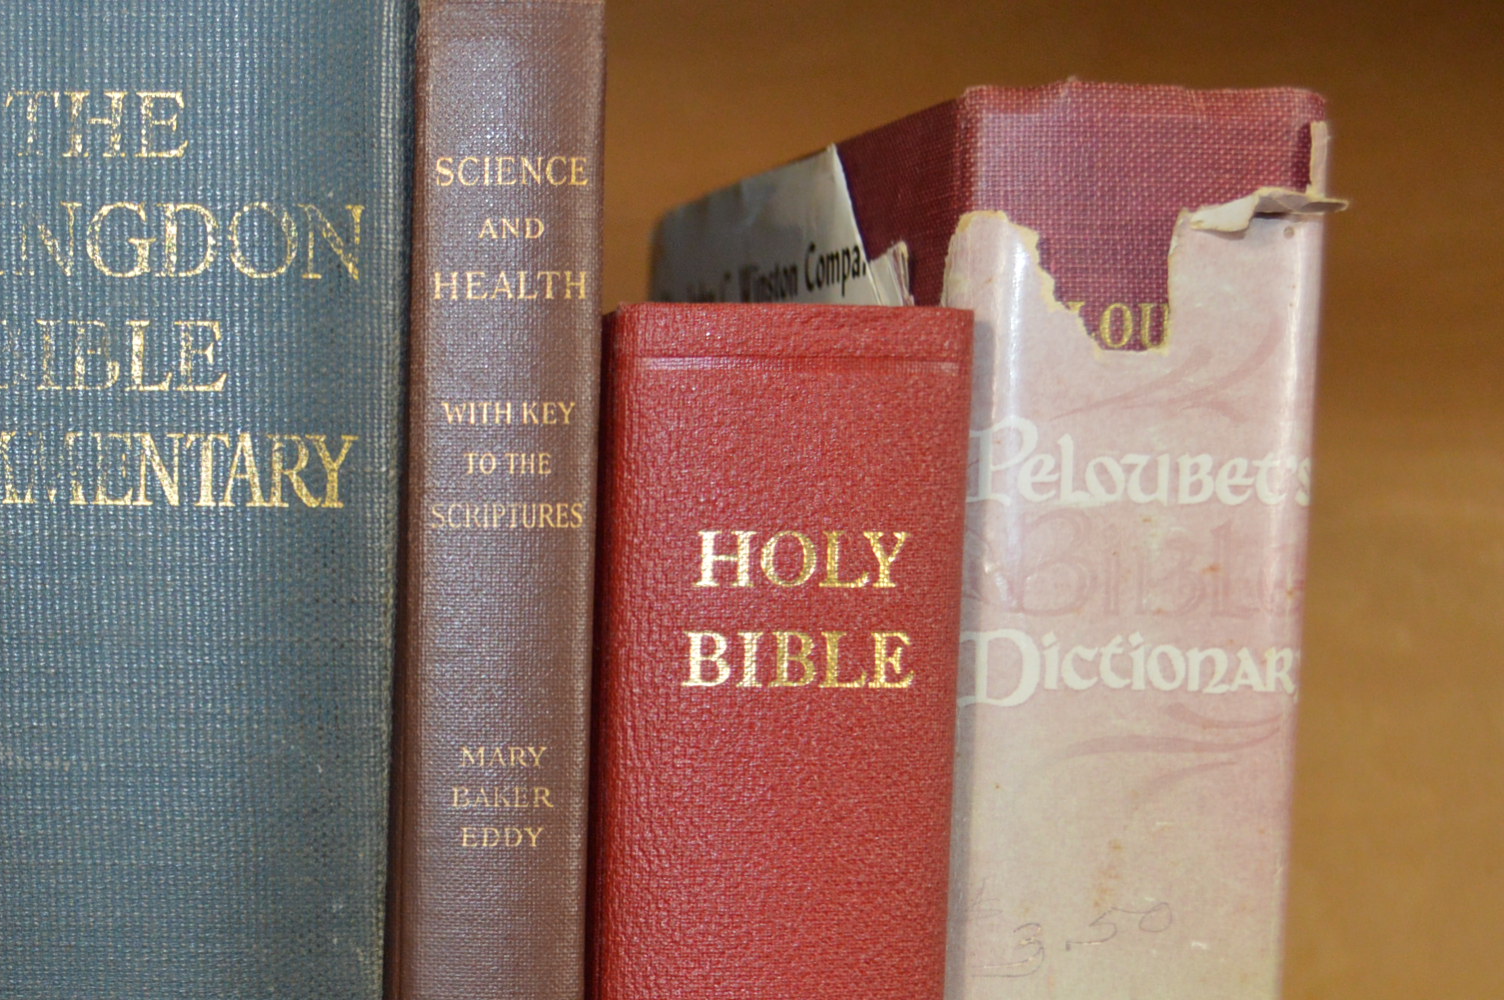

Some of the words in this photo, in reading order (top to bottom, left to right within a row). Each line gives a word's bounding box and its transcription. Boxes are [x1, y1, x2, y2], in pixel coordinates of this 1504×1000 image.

[4, 89, 190, 159] THE
[435, 155, 589, 188] SCIENCE
[477, 217, 545, 240] AND
[804, 241, 867, 298] Compa
[432, 270, 588, 301] HEALTH
[442, 402, 513, 425] WITH
[521, 402, 577, 426] KEY
[463, 452, 500, 475] TO
[504, 453, 552, 475] THE
[431, 502, 584, 530] SCRIPTURES
[693, 530, 911, 588] HOLY
[681, 630, 914, 688] BIBLE
[957, 628, 1300, 707] Dictionar
[459, 746, 548, 769] MARY
[451, 785, 555, 808] BAKER
[461, 826, 544, 848] EDDY
